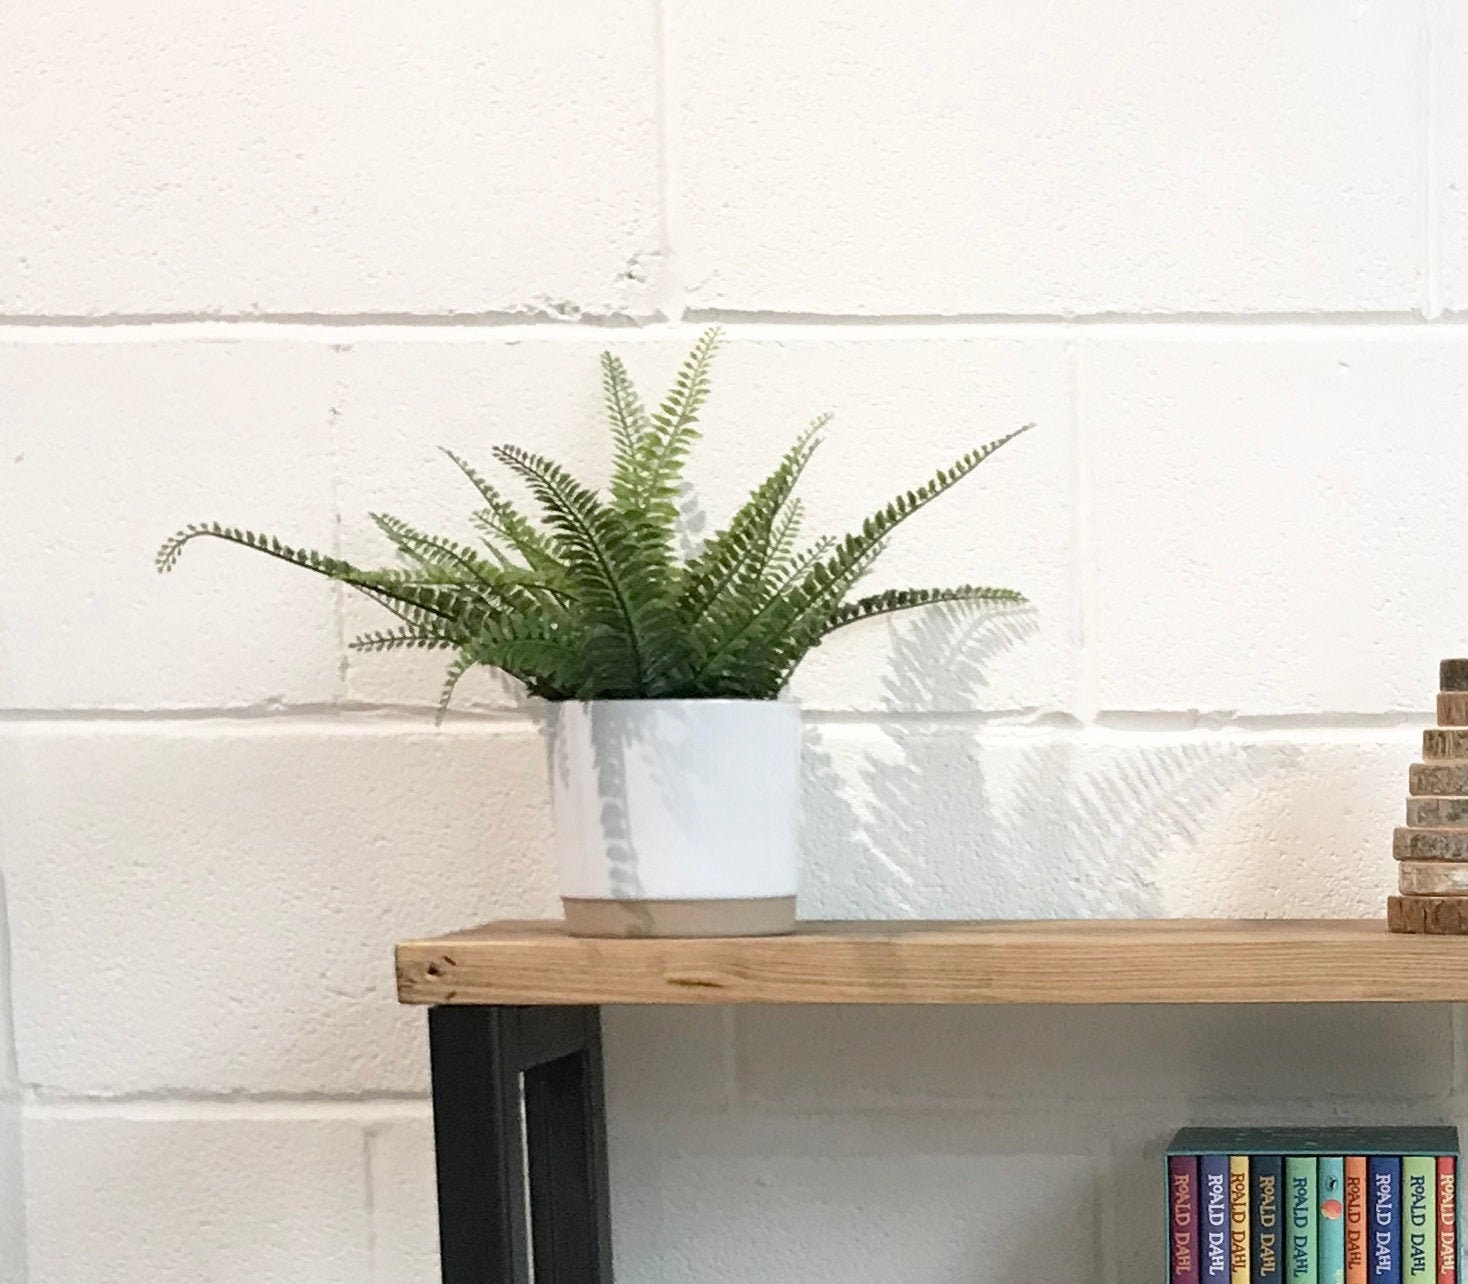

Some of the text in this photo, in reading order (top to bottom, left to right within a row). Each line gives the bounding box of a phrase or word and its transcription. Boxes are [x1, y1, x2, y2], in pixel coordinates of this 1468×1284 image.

[1173, 1174, 1191, 1275] ROALD DAHL
[1208, 1174, 1225, 1276] ROALD DAHL
[1230, 1172, 1247, 1273] ROALD DAHL
[1259, 1175, 1276, 1276] ROALD DAHL
[1293, 1177, 1308, 1278] ROALD DAHL
[1347, 1176, 1362, 1270] ROALD DAHL
[1375, 1174, 1392, 1275] ROALD DAHL
[1411, 1175, 1426, 1276] ROALD DAHL
[1440, 1174, 1455, 1275] ROALD DAHL
